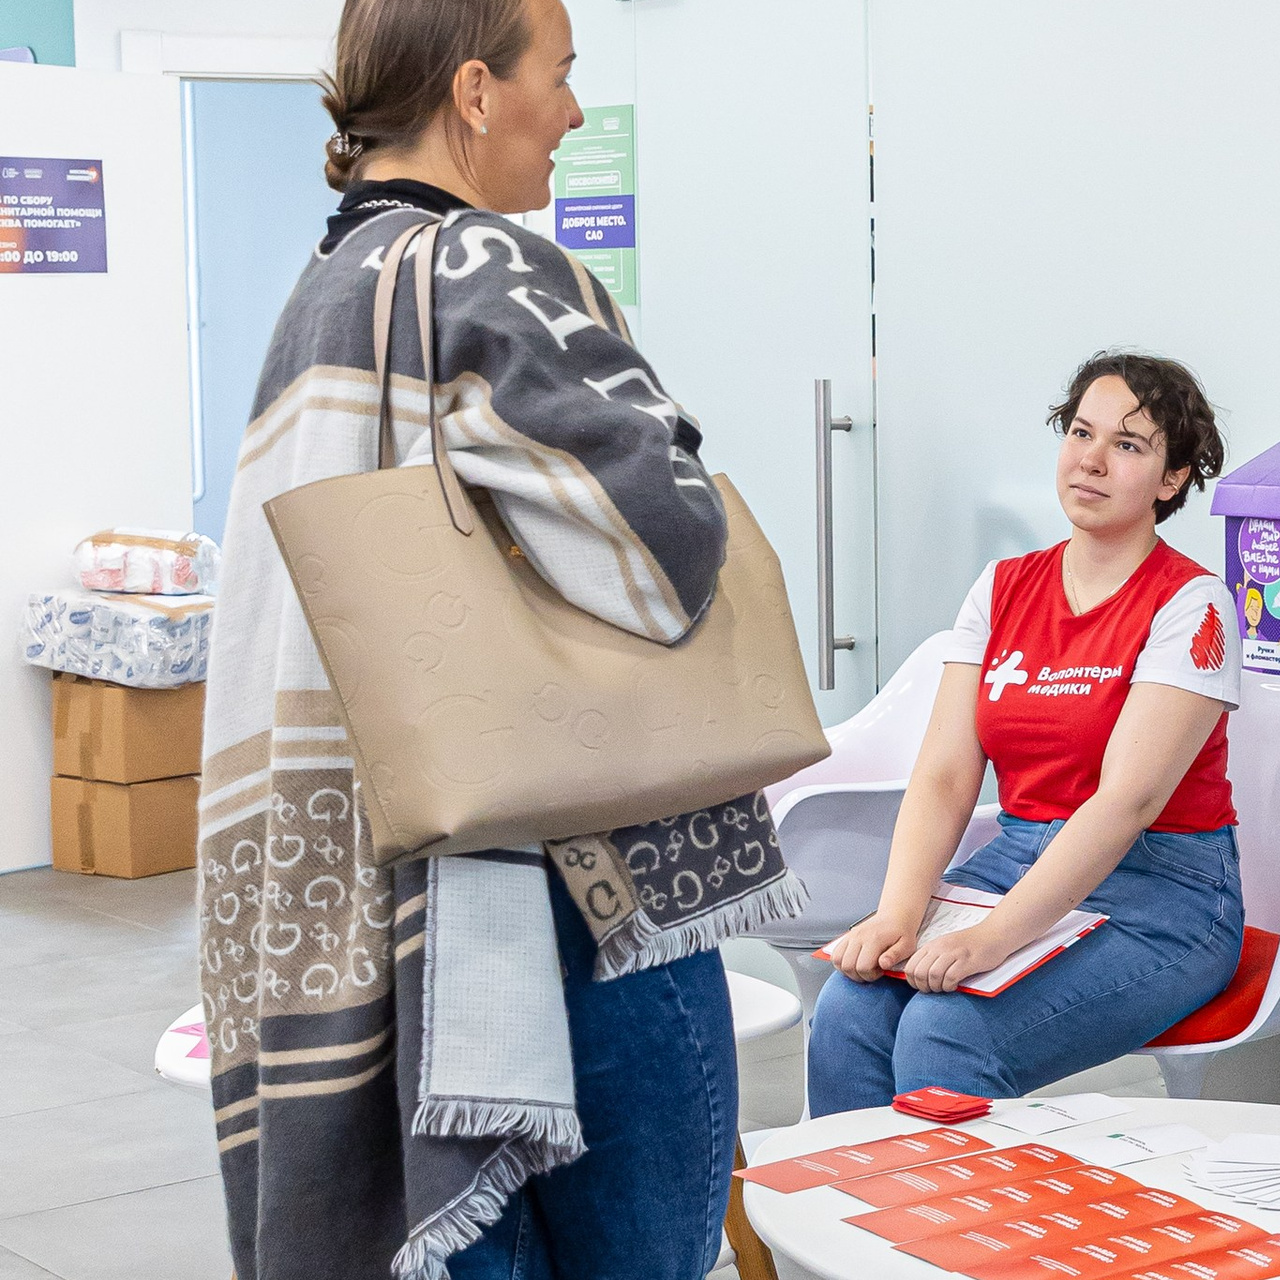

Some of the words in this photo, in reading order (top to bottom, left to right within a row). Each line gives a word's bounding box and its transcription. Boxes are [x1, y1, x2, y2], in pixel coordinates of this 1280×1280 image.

[3, 195, 19, 205] ПО
[20, 196, 53, 205] СБОРУ
[0, 206, 55, 217] НИТАРНОЙ
[56, 208, 102, 218] ПОМОЩИ
[562, 217, 596, 229] ДОБРОЕ
[596, 215, 626, 226] МЕСТО.
[585, 230, 604, 240] САО
[23, 250, 44, 264] ДО
[45, 250, 79, 262] 19:00
[1037, 665, 1123, 684] Волонтеры
[1027, 682, 1092, 697] медики
